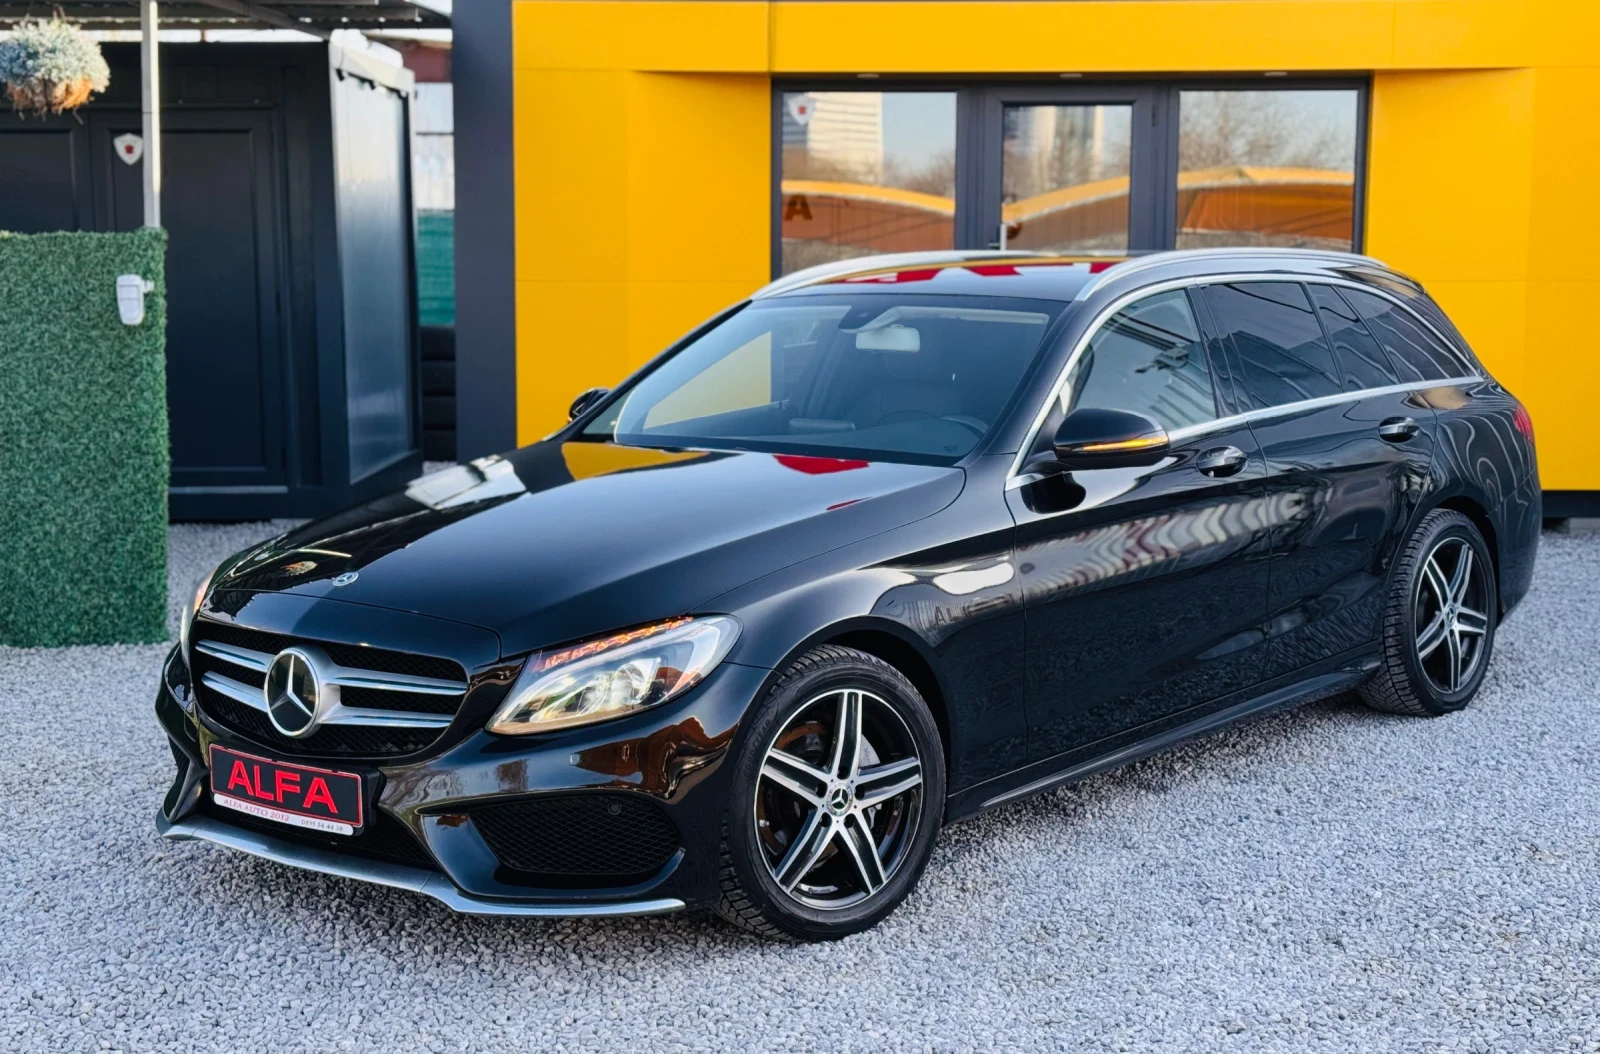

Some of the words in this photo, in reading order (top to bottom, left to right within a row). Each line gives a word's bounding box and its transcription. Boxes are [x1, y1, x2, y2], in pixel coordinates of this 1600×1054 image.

[227, 760, 339, 814] ALFA
[223, 799, 243, 810] ALFA
[244, 805, 269, 817] AUTO
[270, 812, 289, 822] 2012
